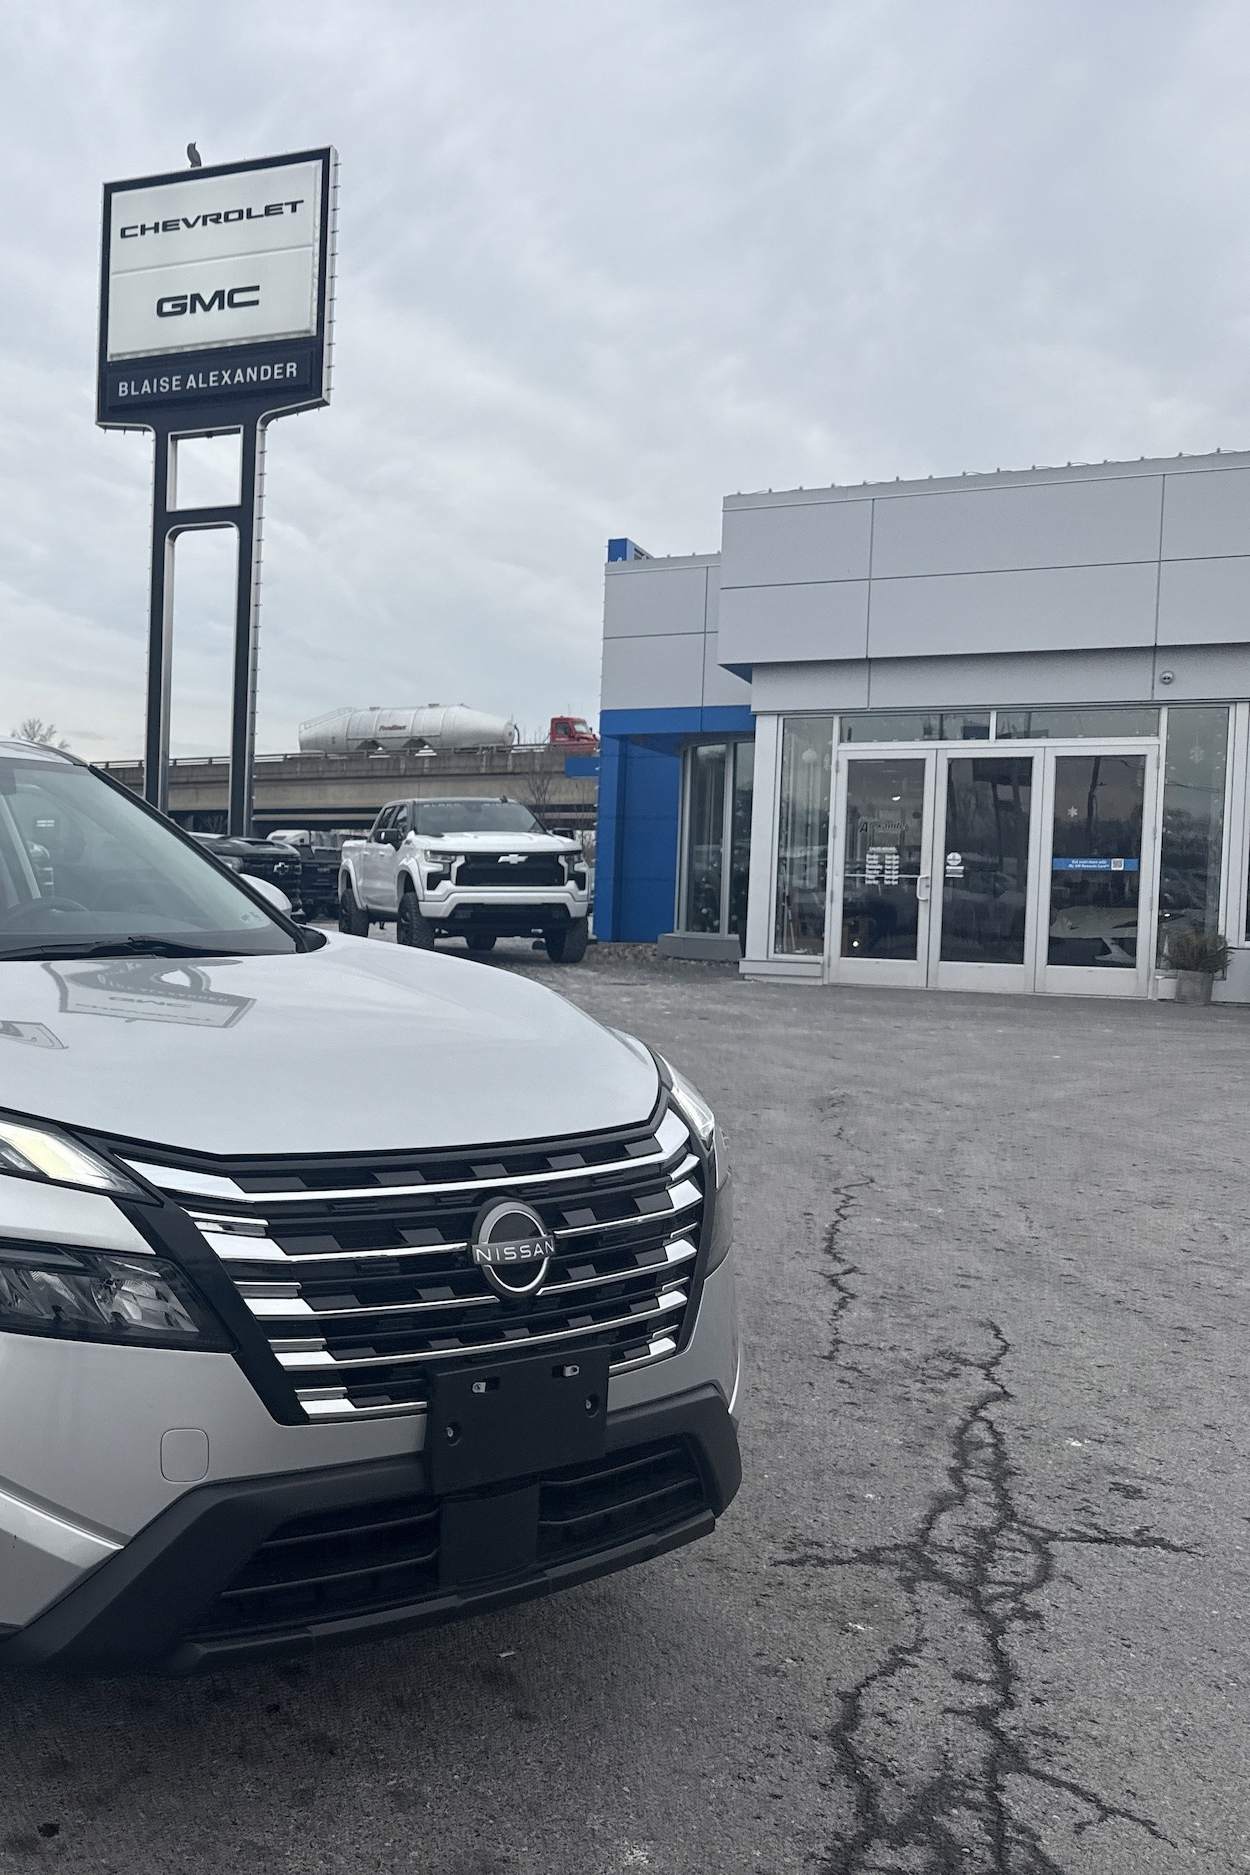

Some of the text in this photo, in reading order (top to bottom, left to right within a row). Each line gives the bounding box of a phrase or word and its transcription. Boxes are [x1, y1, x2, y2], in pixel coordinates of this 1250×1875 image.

[120, 200, 305, 239] CHEVROLET
[156, 285, 260, 318] GMC
[118, 362, 298, 397] BLAISE ALEXANDER
[475, 1238, 554, 1262] NISSAN
